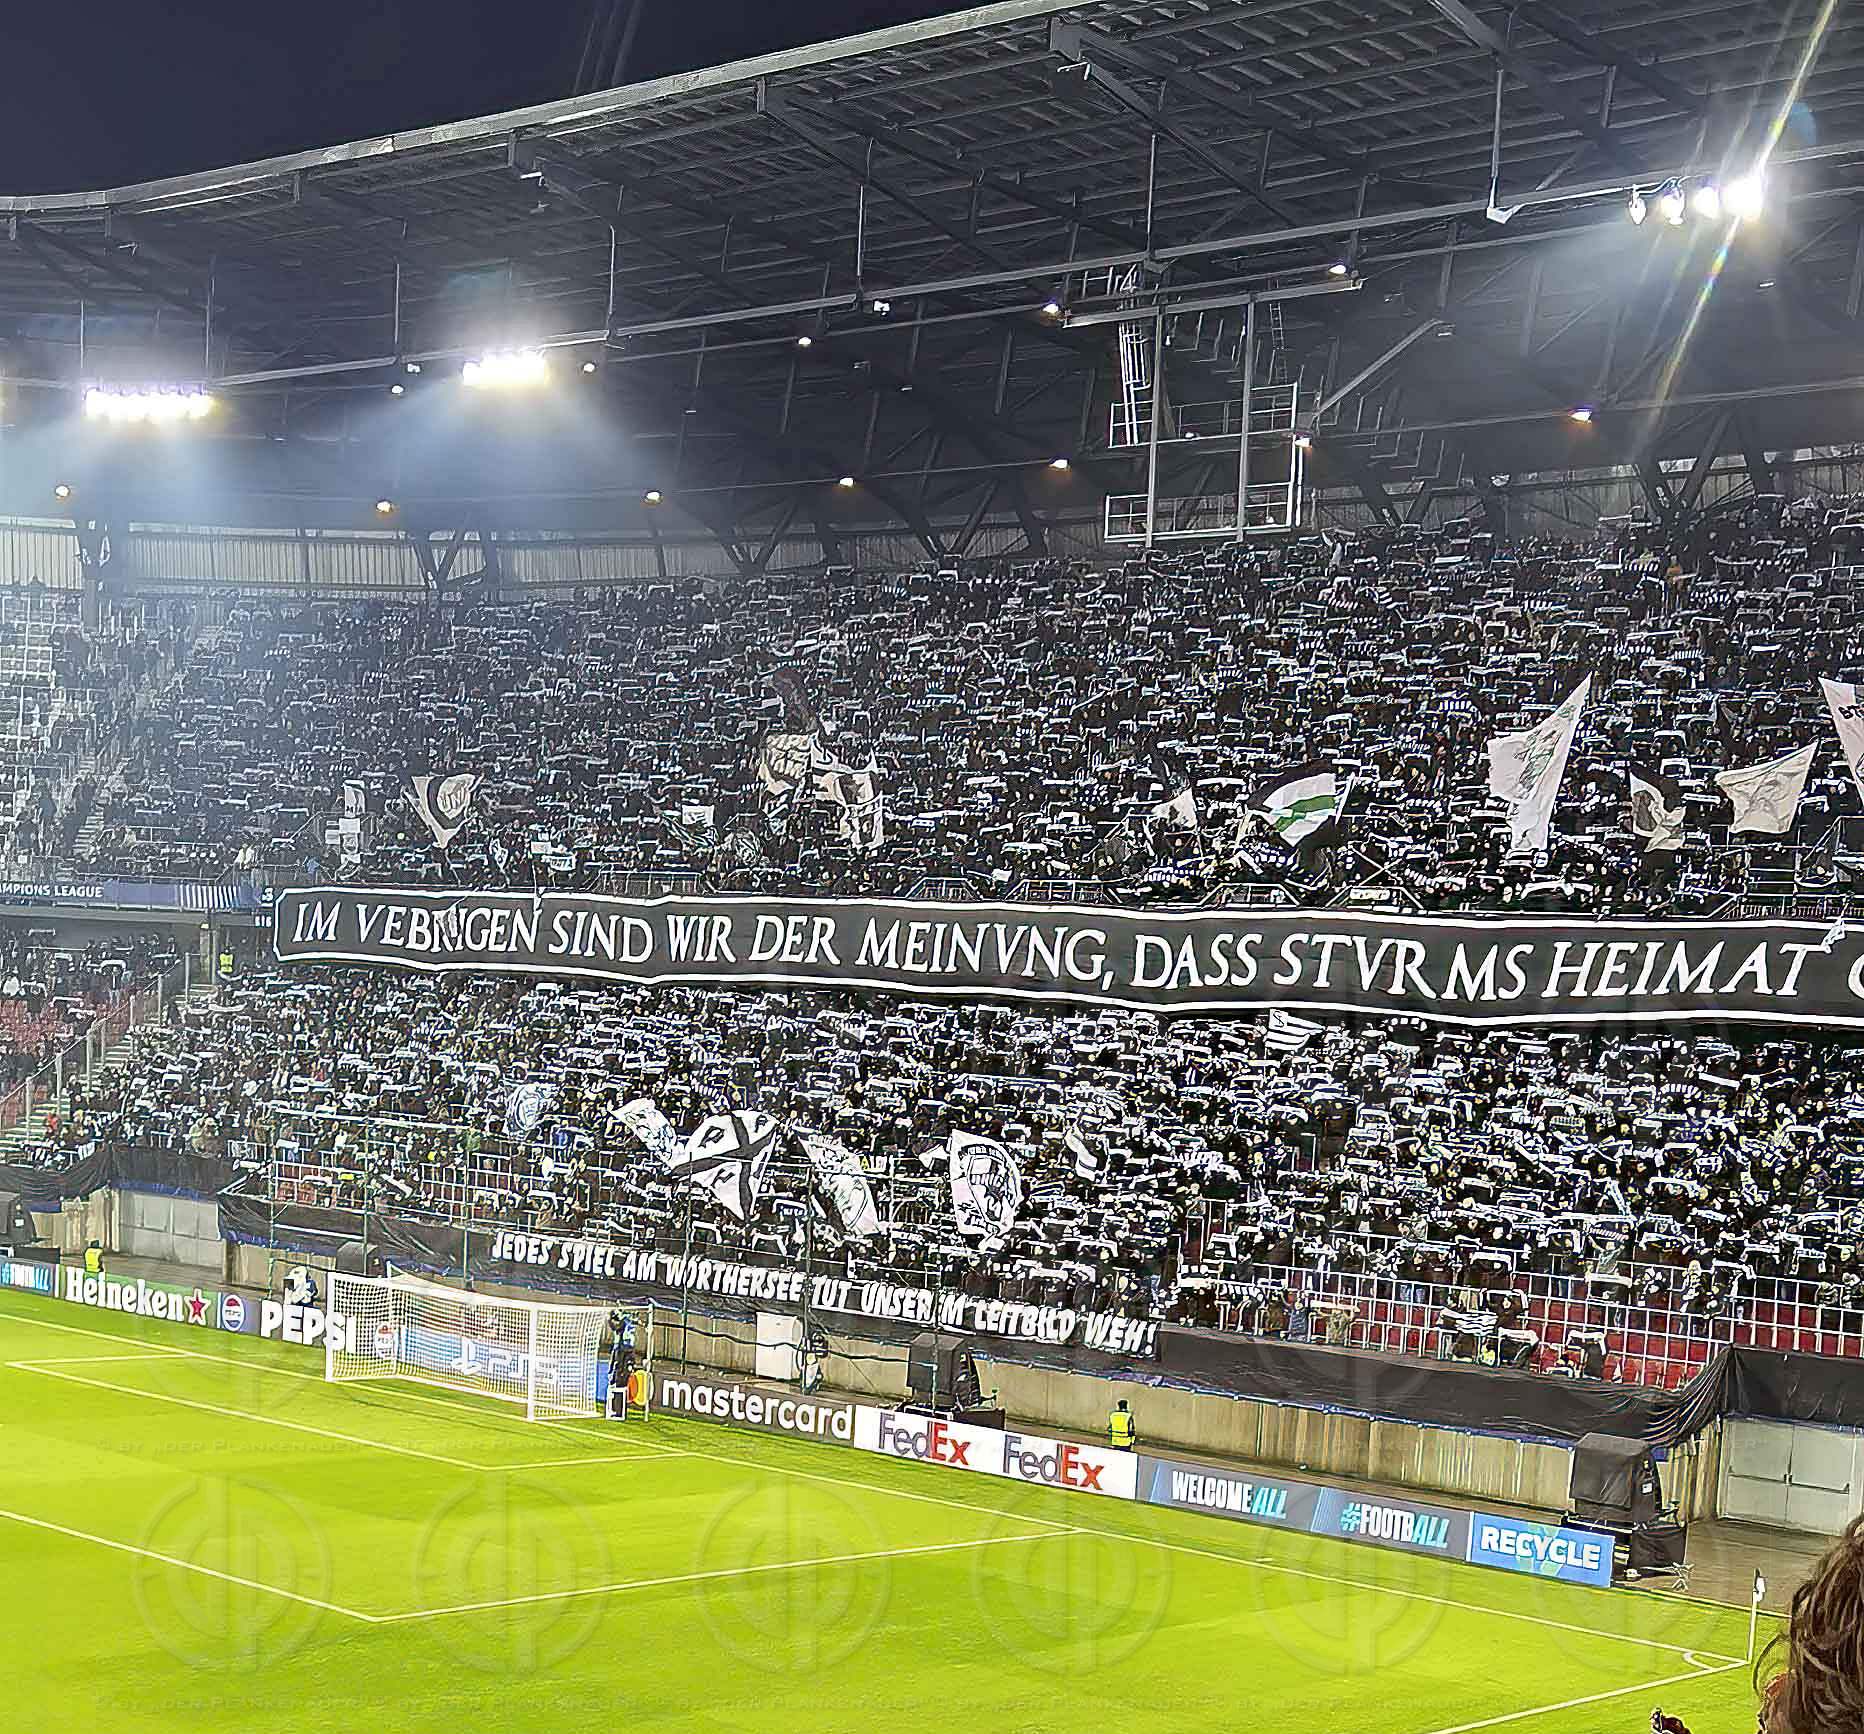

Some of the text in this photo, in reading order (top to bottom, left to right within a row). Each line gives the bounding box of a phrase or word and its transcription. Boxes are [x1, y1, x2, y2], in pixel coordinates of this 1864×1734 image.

[0, 883, 104, 898] MPIONS LEAGUE
[292, 901, 341, 943] IM
[548, 910, 654, 963] SIND
[667, 914, 736, 963] WIR
[749, 914, 840, 965] DER
[855, 918, 1114, 991] MEINVNG,
[1131, 933, 1261, 989] DASS
[1542, 941, 1826, 998] HEIMAT
[65, 1266, 185, 1321] Heineken
[492, 1232, 550, 1264] JEDES
[558, 1241, 616, 1276] SPIEL
[623, 1252, 657, 1281] AM
[812, 1275, 853, 1307] TUT
[861, 1283, 965, 1326] UNSERM
[974, 1300, 1076, 1342] LEITBILD
[1085, 1312, 1156, 1355] WEH!
[261, 1299, 357, 1352] PEPSI
[662, 1379, 852, 1440] mastercard
[878, 1412, 971, 1467] FedEx
[1002, 1433, 1105, 1491] FedEx
[1340, 1502, 1450, 1548] #FOOTBALL
[1480, 1525, 1602, 1569] RECYCLE
